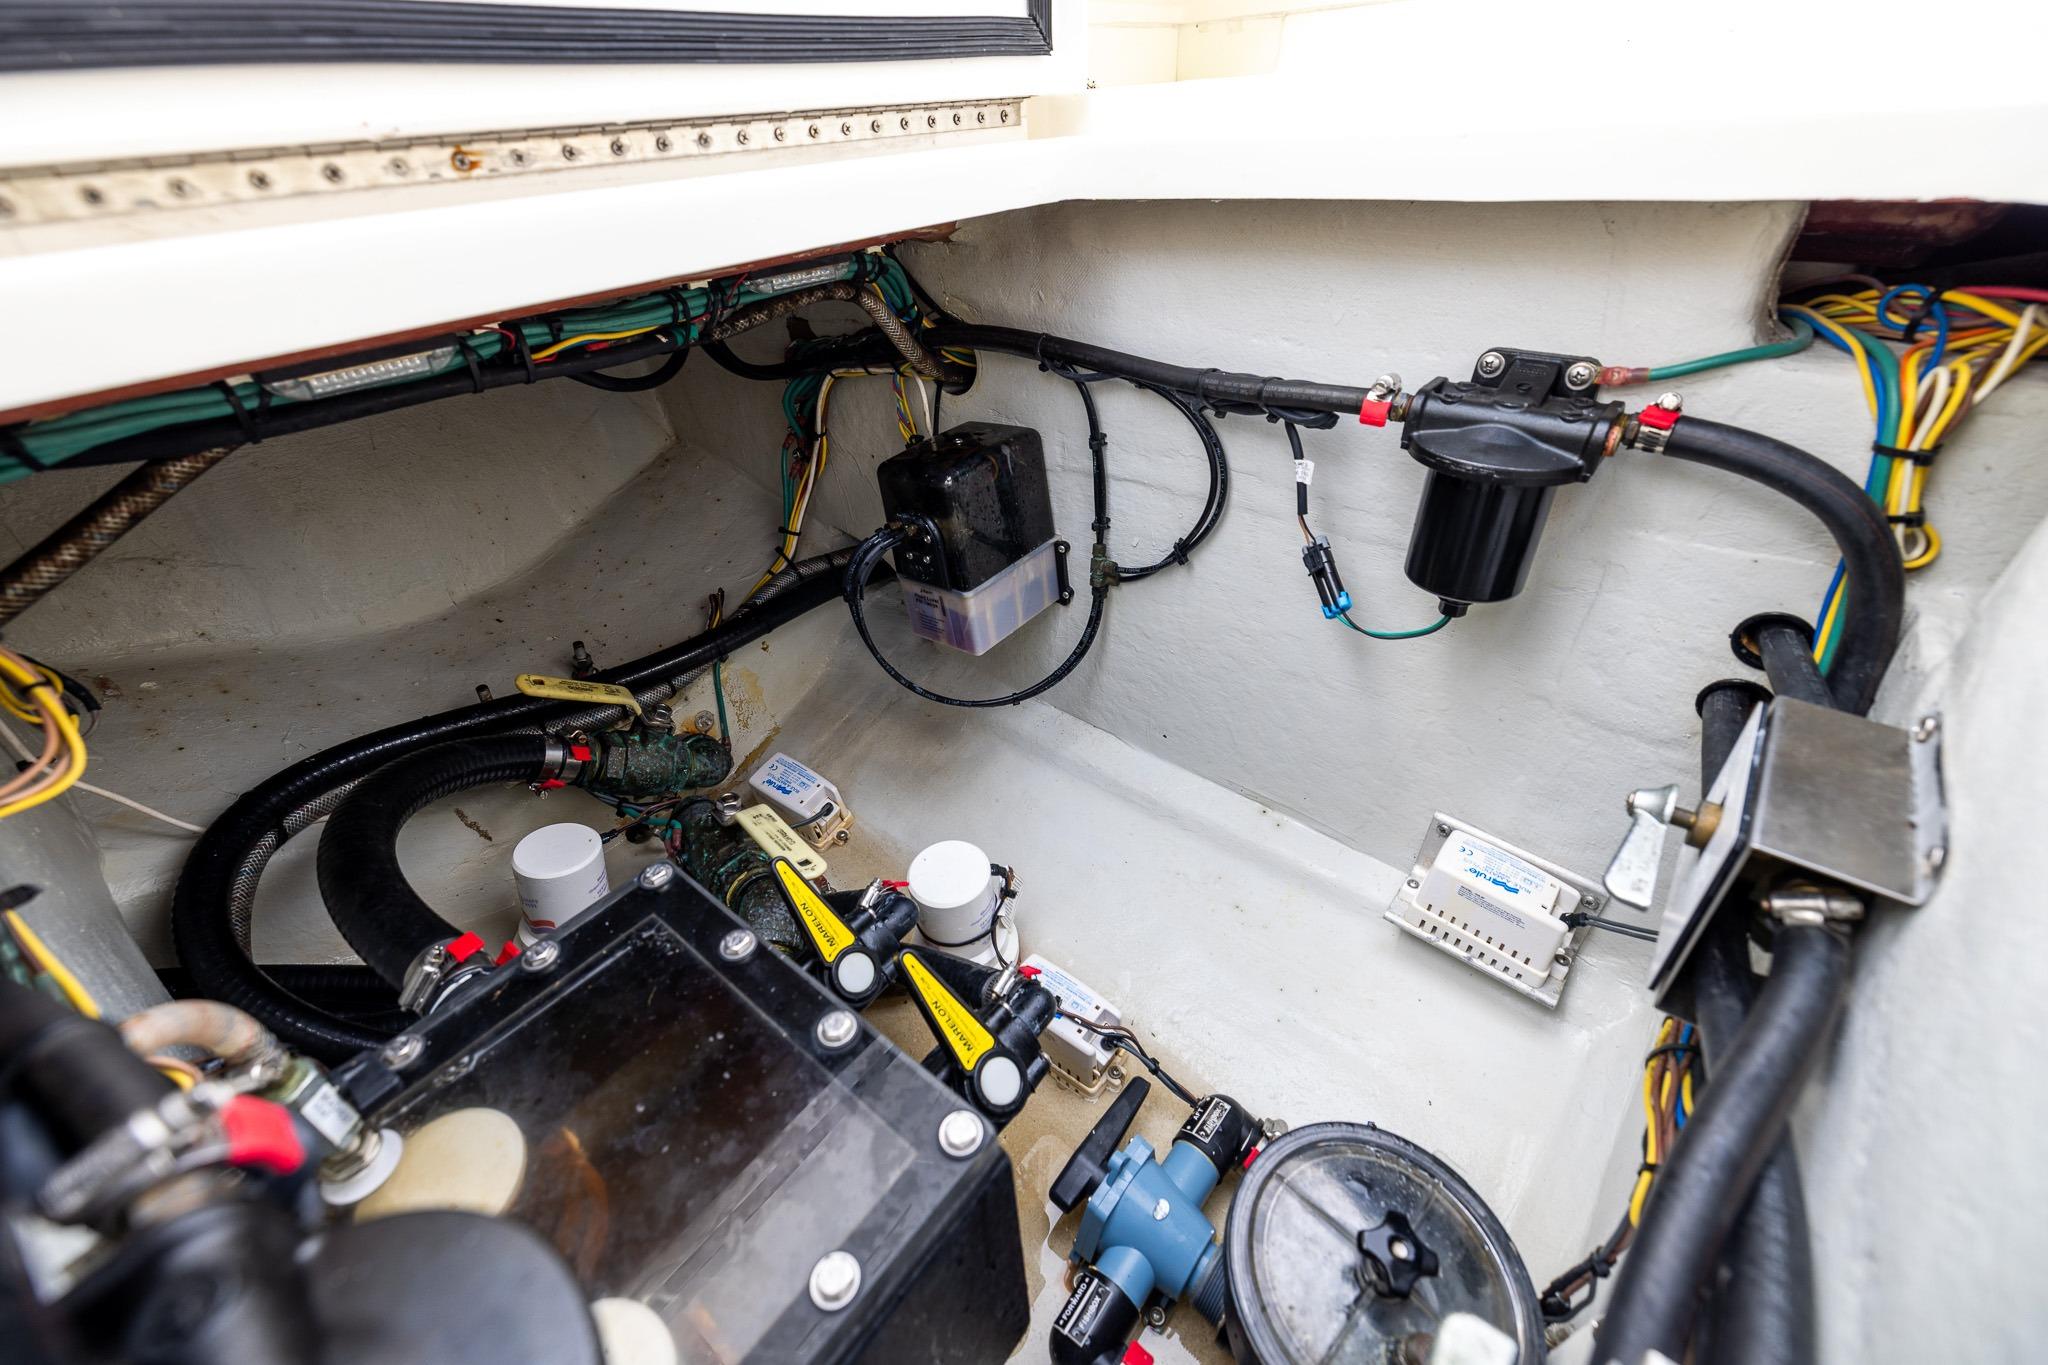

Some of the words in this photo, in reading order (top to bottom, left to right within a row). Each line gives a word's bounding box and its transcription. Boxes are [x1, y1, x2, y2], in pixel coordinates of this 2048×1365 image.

[1468, 867, 1492, 882] rule
[800, 901, 836, 948] MARELON
[932, 1000, 974, 1052] MARELON
[1193, 1107, 1203, 1120] AFT
[1062, 1283, 1088, 1320] FORWARD
[1078, 1295, 1101, 1329] FISHBOX
